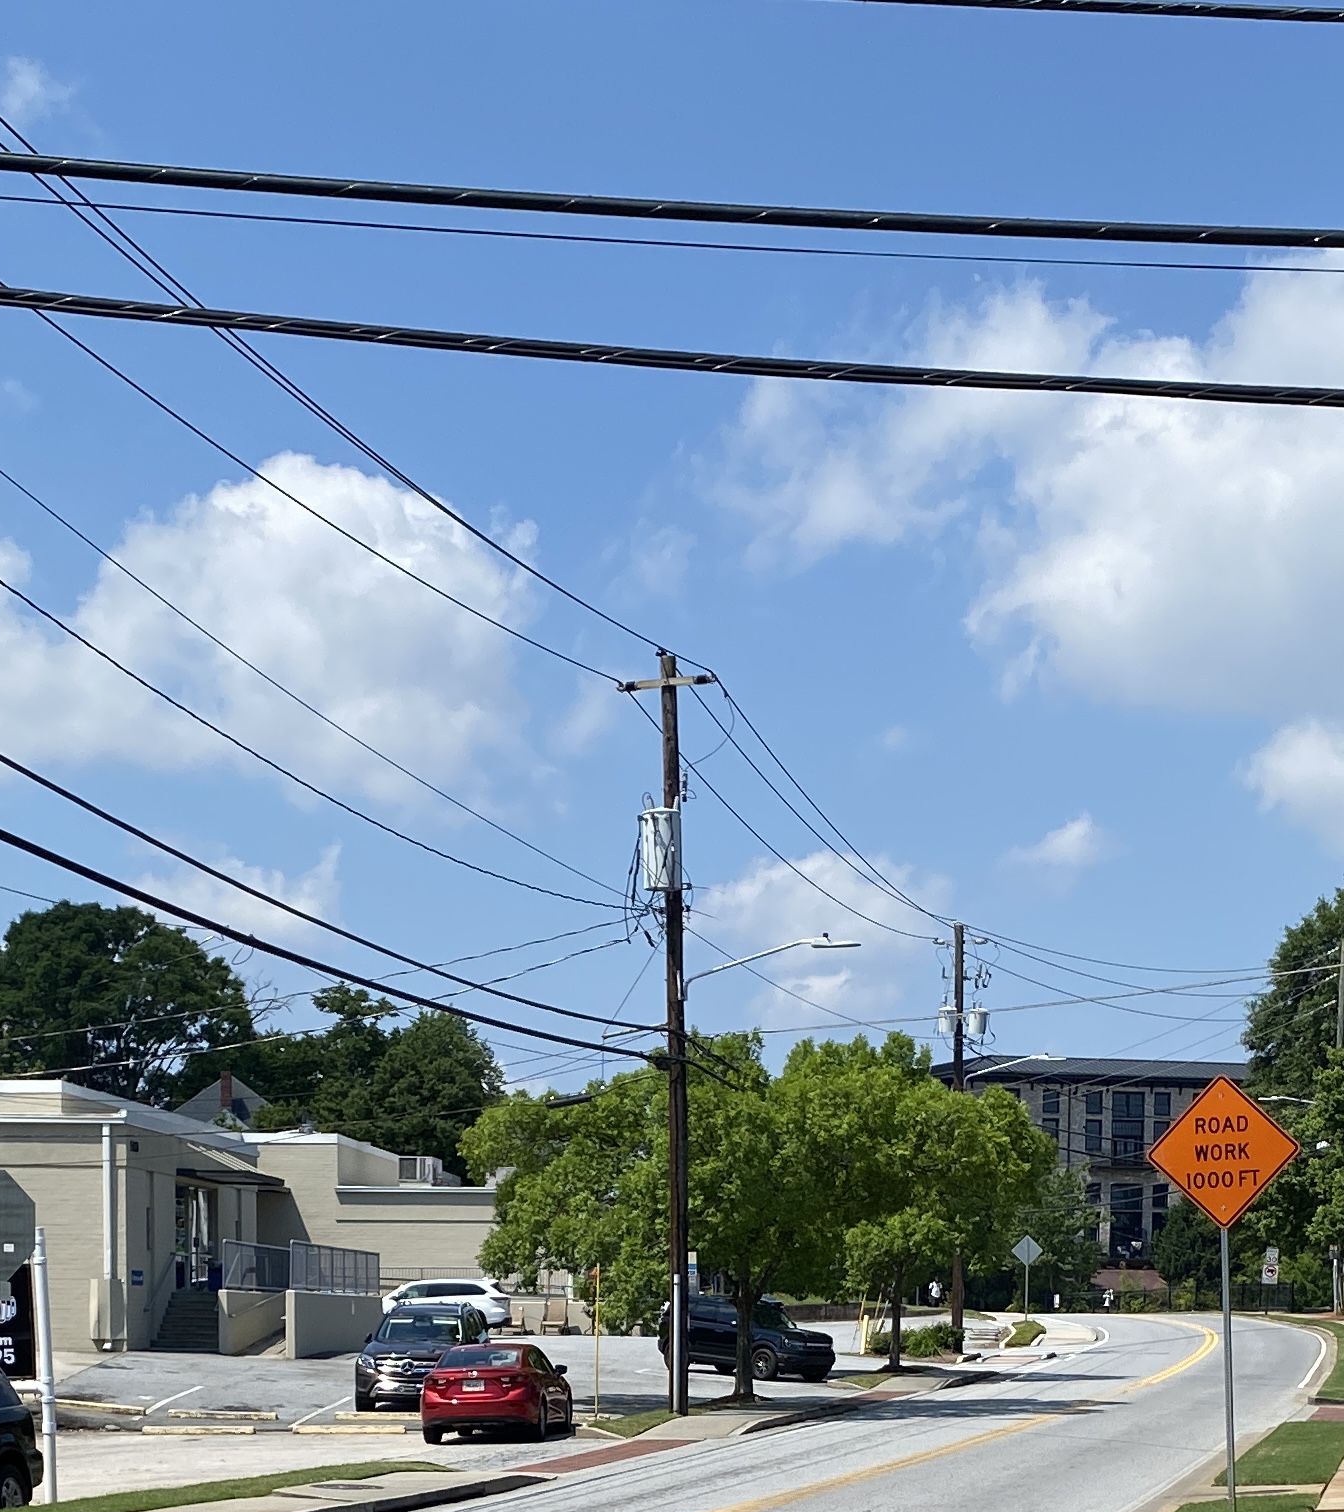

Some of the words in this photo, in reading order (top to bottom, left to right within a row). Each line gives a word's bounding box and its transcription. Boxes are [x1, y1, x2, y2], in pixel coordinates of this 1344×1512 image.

[1194, 1115, 1249, 1135] ROAD
[1194, 1142, 1250, 1162] WORK
[1186, 1170, 1234, 1190] 1000
[1238, 1169, 1261, 1188] FT
